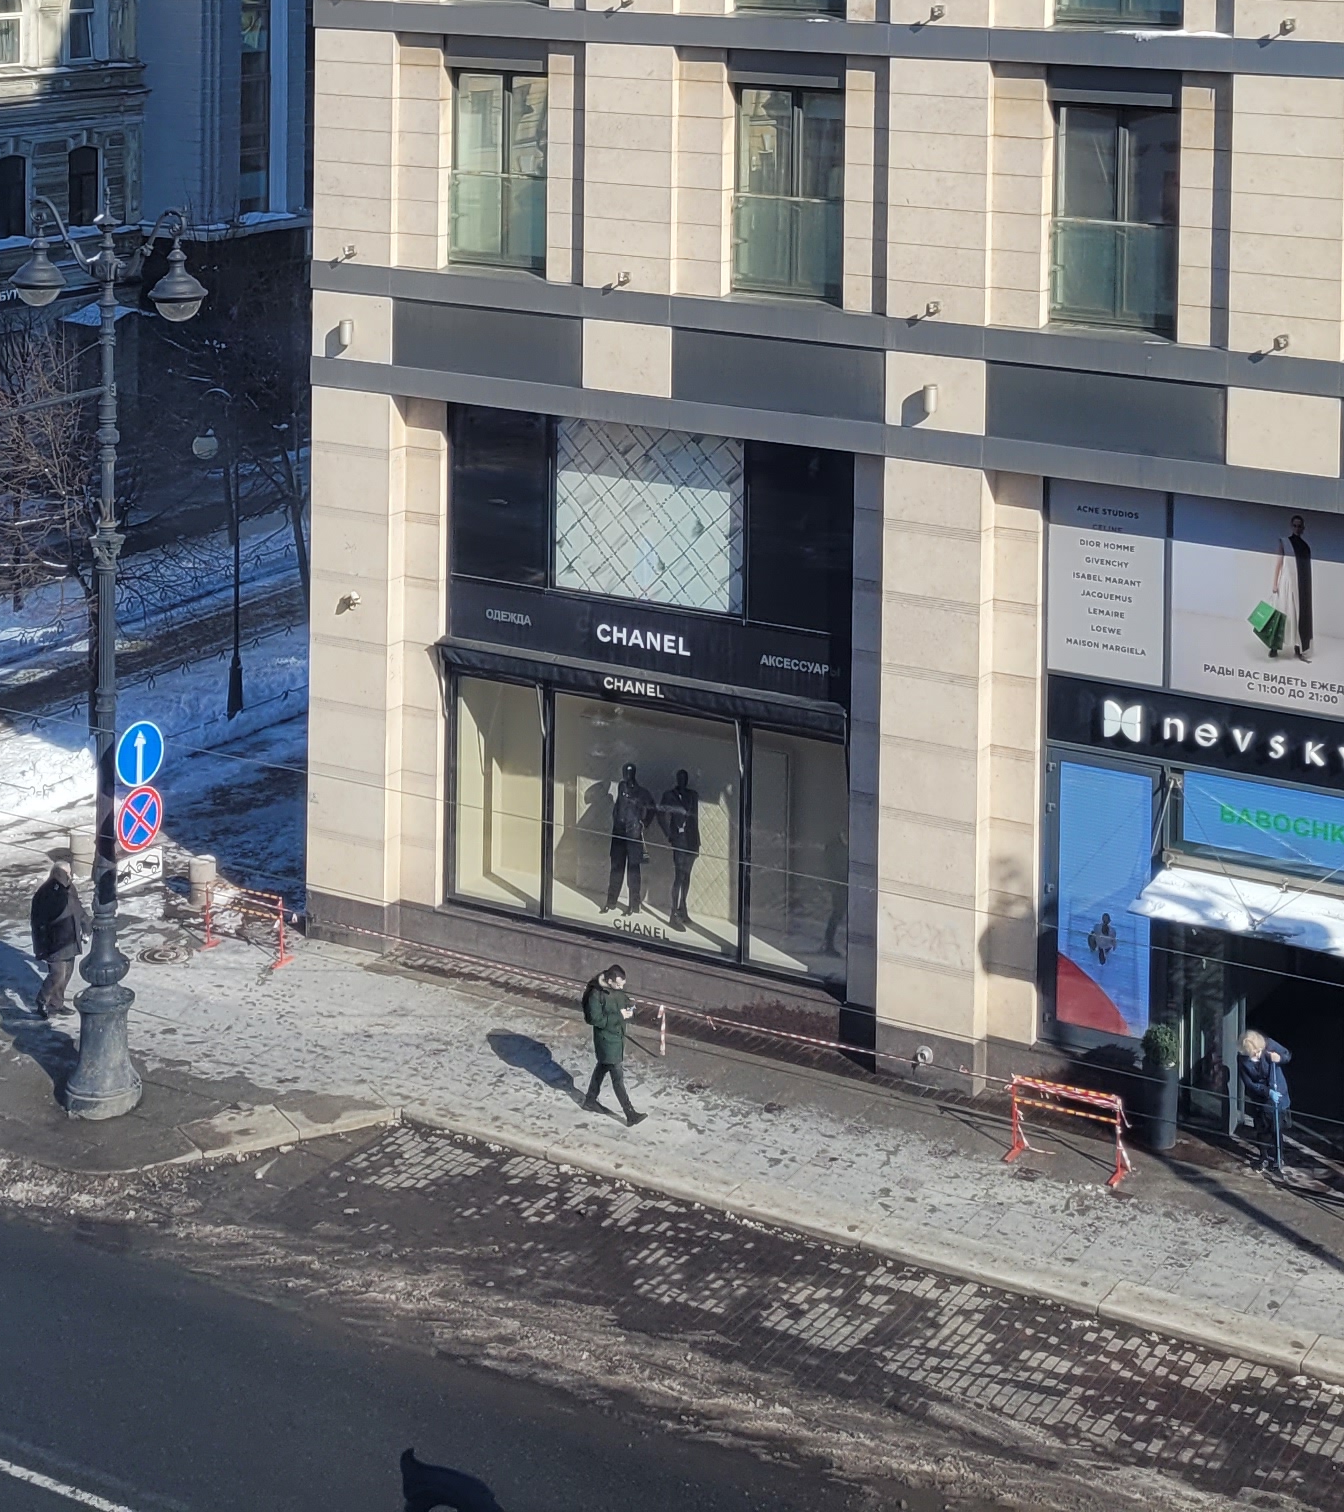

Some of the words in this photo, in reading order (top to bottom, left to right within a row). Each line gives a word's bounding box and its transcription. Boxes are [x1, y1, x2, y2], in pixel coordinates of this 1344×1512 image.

[1077, 505, 1099, 515] ACNE
[1102, 508, 1139, 519] STUDIOS
[1079, 538, 1101, 548] DIOR
[1103, 542, 1135, 553] HOMME
[1084, 556, 1129, 568] GIVENCHY
[1072, 571, 1102, 582] ISABEL
[1105, 576, 1142, 588] MARANT
[1080, 589, 1133, 603] JACQUEMUS
[485, 608, 532, 627] ОДЕЖДА
[1087, 607, 1125, 619] LEMAIRE
[1090, 624, 1122, 635] LOEWE
[596, 623, 691, 656] CHANEL
[1066, 638, 1100, 649] MAISON
[1102, 643, 1147, 656] MARGIELA
[1203, 663, 1235, 677] РАДЫ
[1237, 669, 1260, 680] ВАС
[1263, 673, 1307, 688] ВИДЕТЬ
[603, 676, 665, 699] CHANEL
[1247, 682, 1255, 691] С
[1257, 683, 1285, 696] 11:00
[1288, 688, 1305, 699] ДО
[1308, 691, 1338, 705] 21:00
[613, 918, 670, 941] CHANEL
